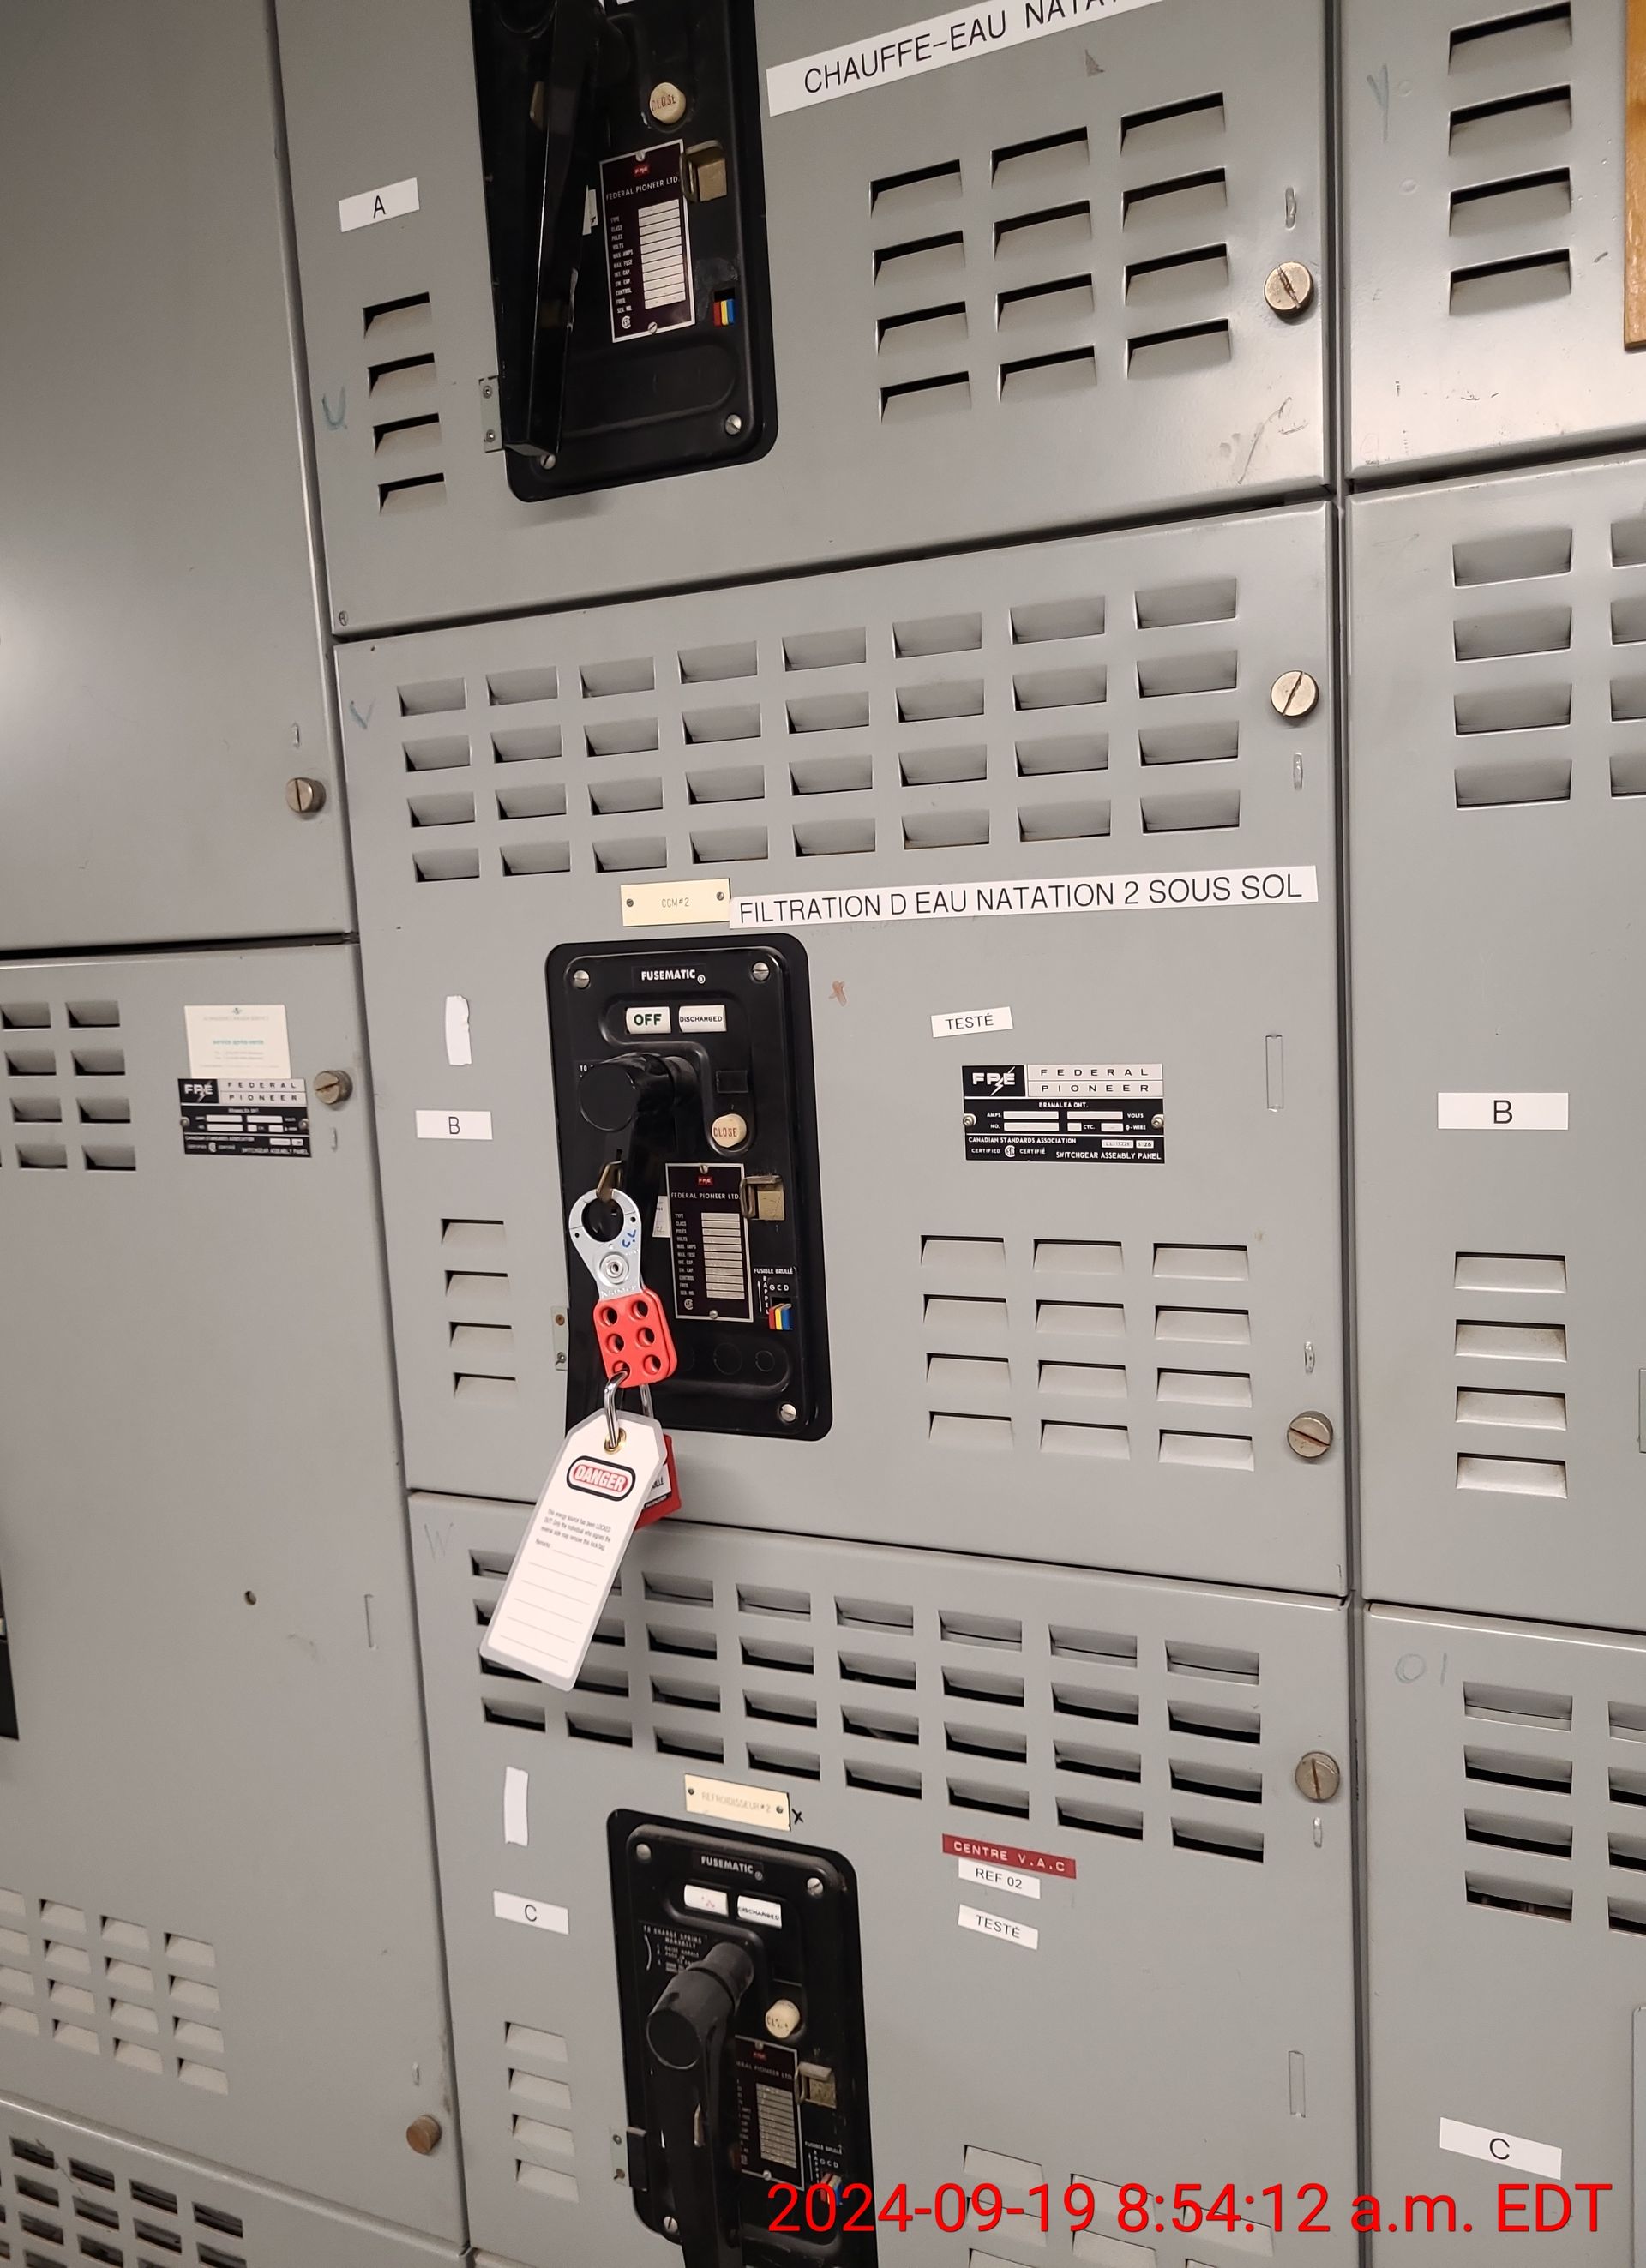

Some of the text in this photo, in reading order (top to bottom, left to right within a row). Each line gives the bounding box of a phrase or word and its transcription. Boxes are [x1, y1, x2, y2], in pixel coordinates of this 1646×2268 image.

[804, 10, 1007, 93] CHAUFFE-EAU
[605, 188, 634, 201] FEDERAL
[635, 180, 664, 193] PIONEER
[373, 195, 386, 218] A
[740, 873, 1302, 924] FILTRATION D EAU NATATION 2 SOUS SOL
[634, 1013, 662, 1026] OFF
[946, 1012, 994, 1030] TESTÉ
[1040, 1069, 1149, 1077] FEDERAL
[1042, 1084, 1149, 1093] PIONEER
[1493, 1100, 1513, 1124] B
[448, 1116, 460, 1135] B
[713, 1127, 737, 1138] CLOSE
[1101, 1151, 1136, 1160] ASSEMBLY
[1138, 1152, 1162, 1161] PANEL
[574, 1464, 628, 1491] DANGER
[700, 1855, 754, 1875] FUSEMATIC
[953, 1841, 1066, 1872] CENTRE V.A.C
[976, 1867, 1023, 1889] REF 02
[524, 1904, 538, 1922] C
[1489, 2138, 1510, 2160] C
